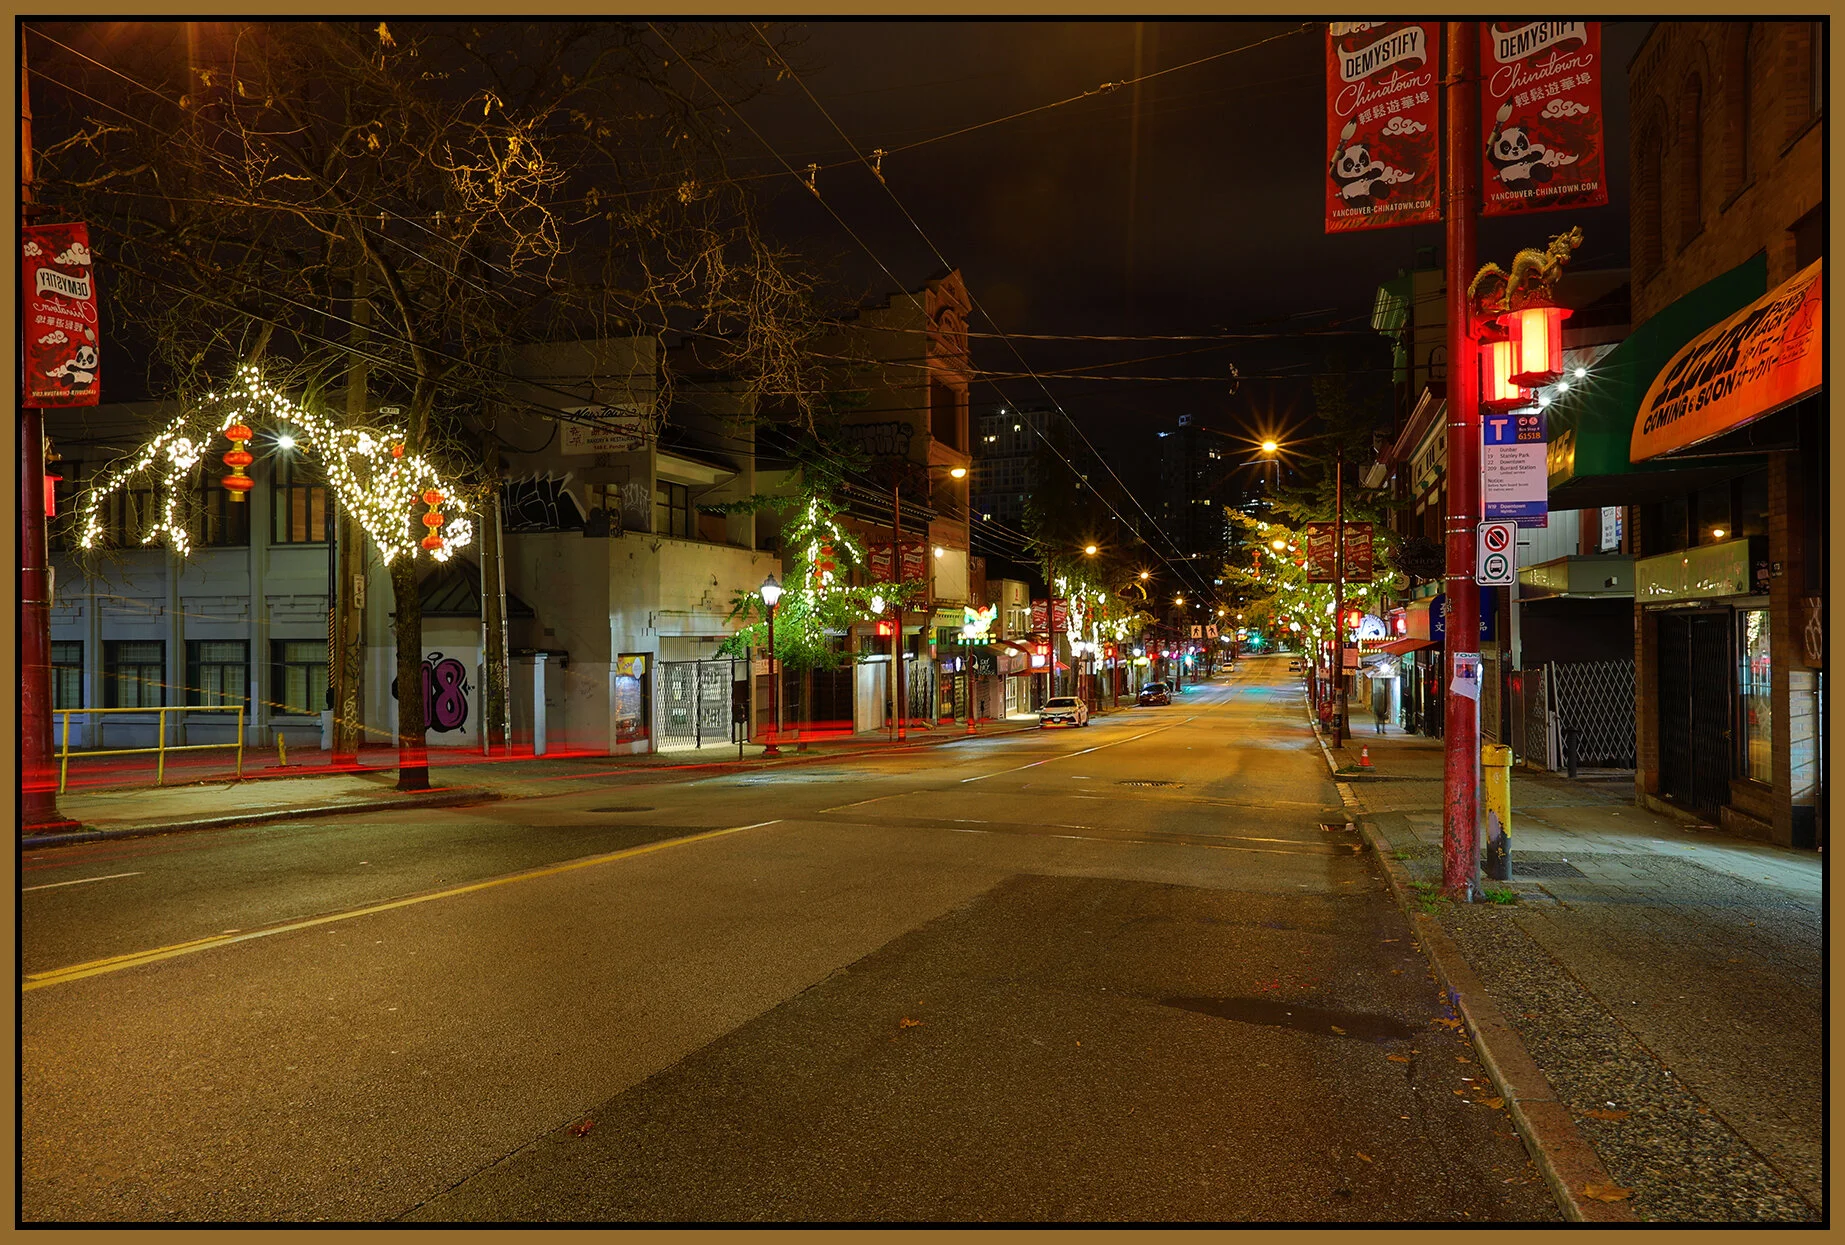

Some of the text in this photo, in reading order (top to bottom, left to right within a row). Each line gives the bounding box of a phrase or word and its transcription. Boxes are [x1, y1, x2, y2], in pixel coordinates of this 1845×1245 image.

[1346, 31, 1418, 78] DEMYSTIFY
[1489, 51, 1593, 98] Chinatown
[1514, 71, 1592, 108] 輕鬆遊華埠
[1335, 70, 1431, 117] Chinatown
[1358, 91, 1430, 125] 輕鬆遊華埠
[1332, 200, 1431, 218] VANCOUVER-CHINATOWN.COM
[1490, 181, 1598, 202] VANCOUVER-CHINATOWN.COM
[1643, 395, 1688, 435] COMING
[1695, 370, 1737, 412] SOON
[1489, 419, 1508, 441] T
[1518, 432, 1541, 440] 61518
